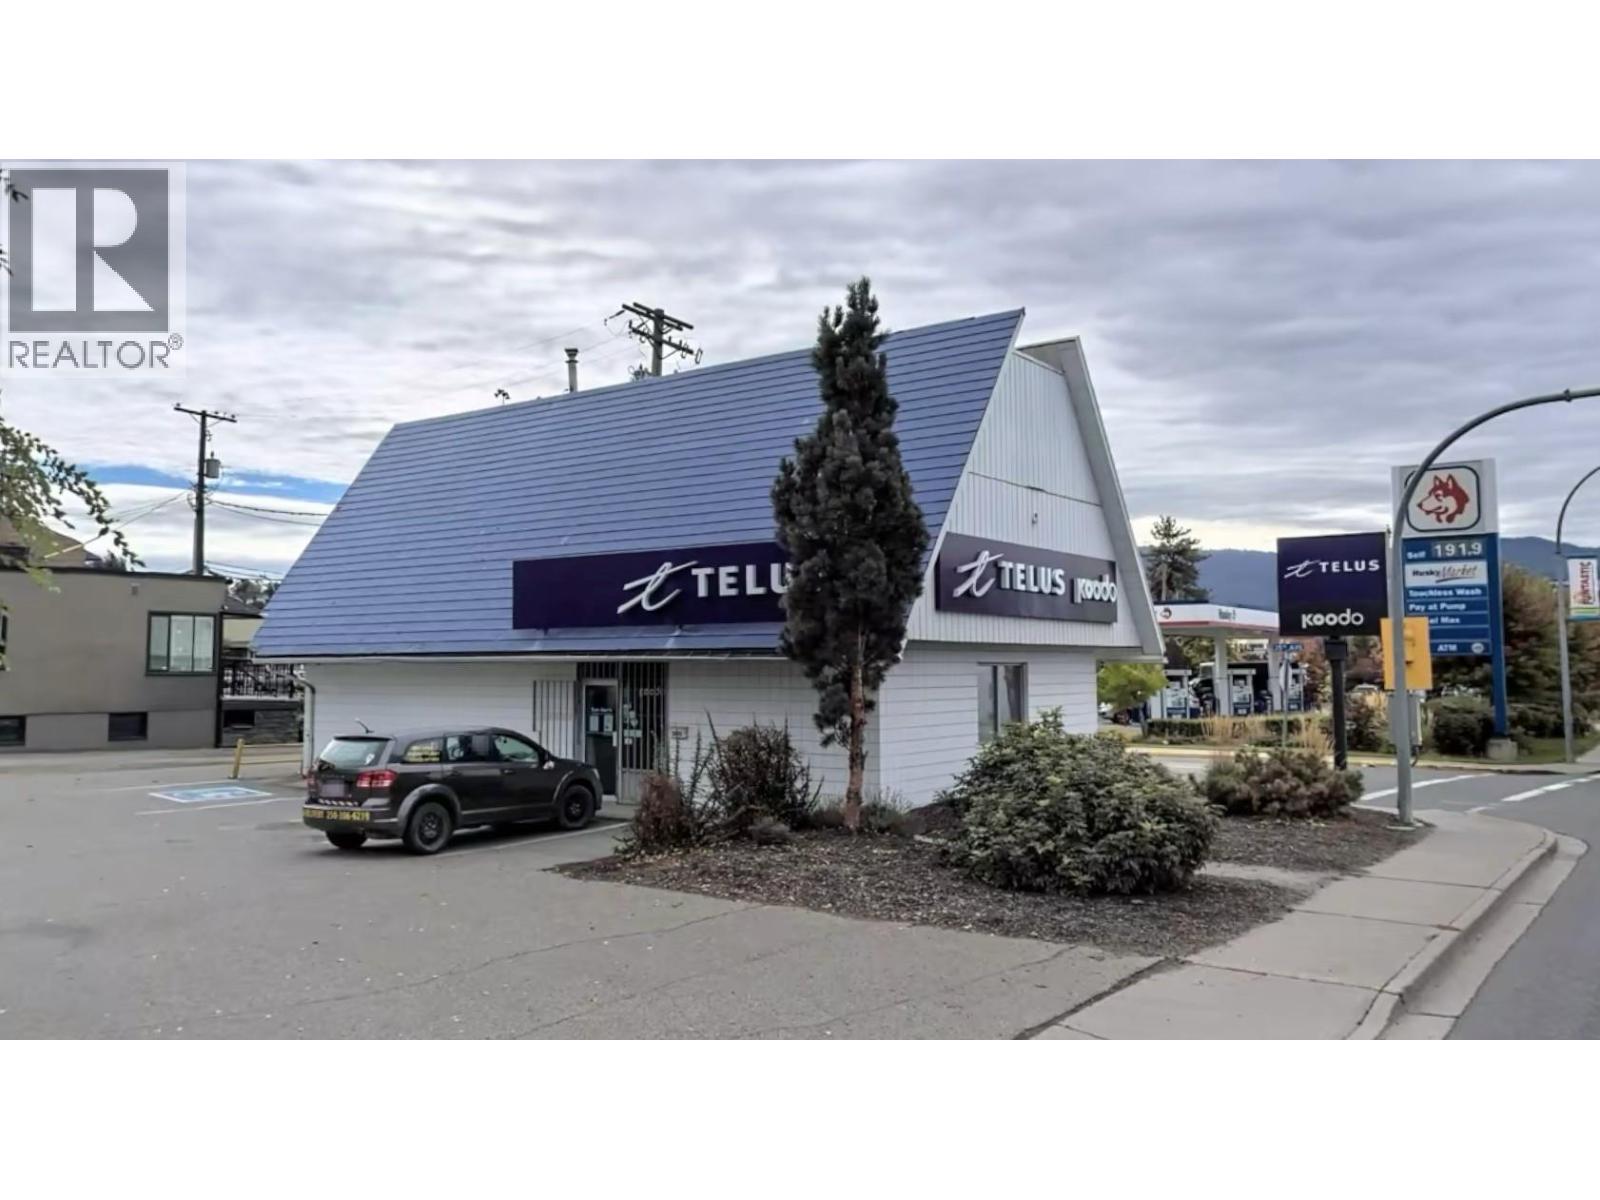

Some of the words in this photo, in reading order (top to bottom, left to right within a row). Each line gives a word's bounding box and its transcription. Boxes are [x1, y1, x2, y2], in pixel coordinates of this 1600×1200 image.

[1434, 542, 1482, 558] 191.9
[998, 560, 1066, 596] TELUS
[1319, 559, 1380, 573] TELUS
[691, 562, 794, 598] TELU
